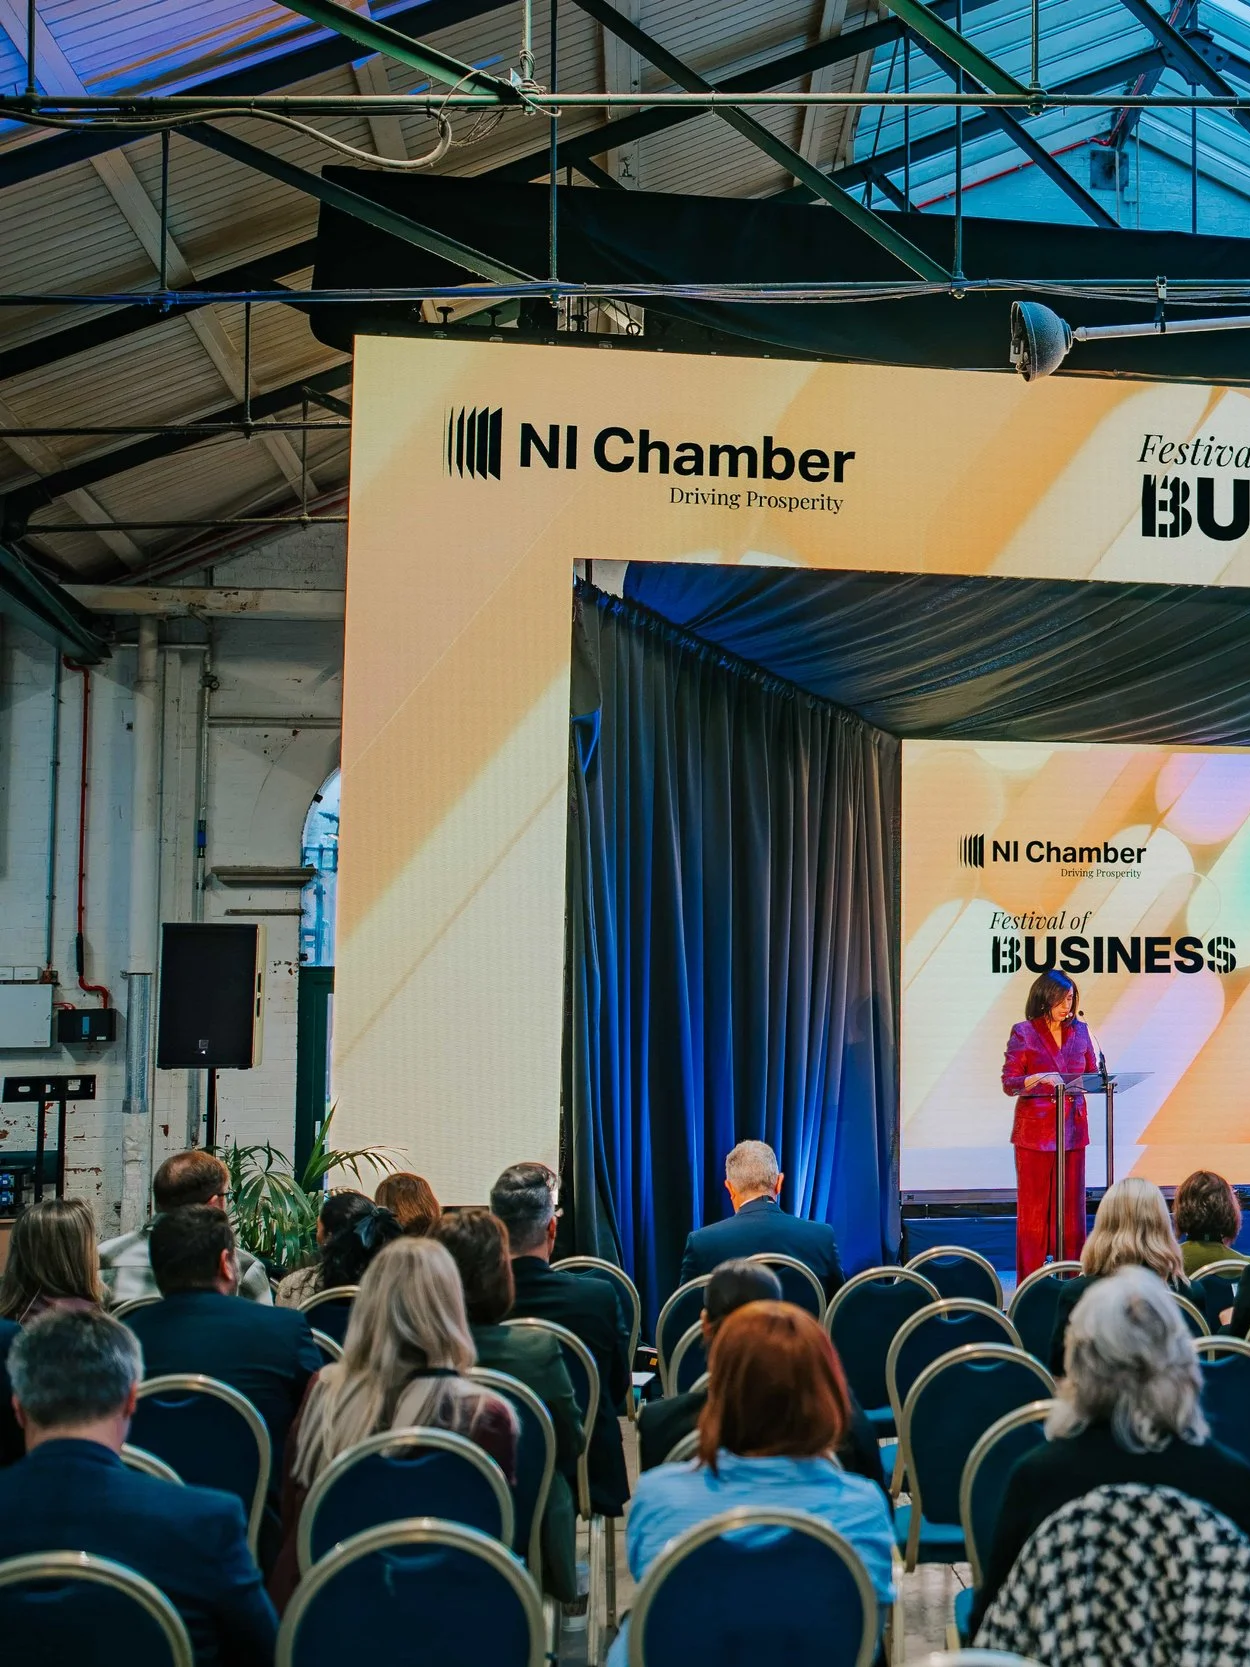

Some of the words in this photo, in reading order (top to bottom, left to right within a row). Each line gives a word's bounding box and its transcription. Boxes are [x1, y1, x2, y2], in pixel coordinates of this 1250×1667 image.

[519, 422, 577, 470] NI
[593, 426, 856, 483] Chamber
[669, 487, 741, 509] Driving
[746, 490, 844, 514] Prosperity
[992, 840, 1019, 863] NI
[1026, 840, 1147, 864] Chamber
[1061, 868, 1094, 879] Driving
[1096, 869, 1142, 879] Prosperity
[989, 911, 1065, 930] Festival
[1070, 911, 1092, 934] of
[991, 935, 1237, 974] BUSINESS
